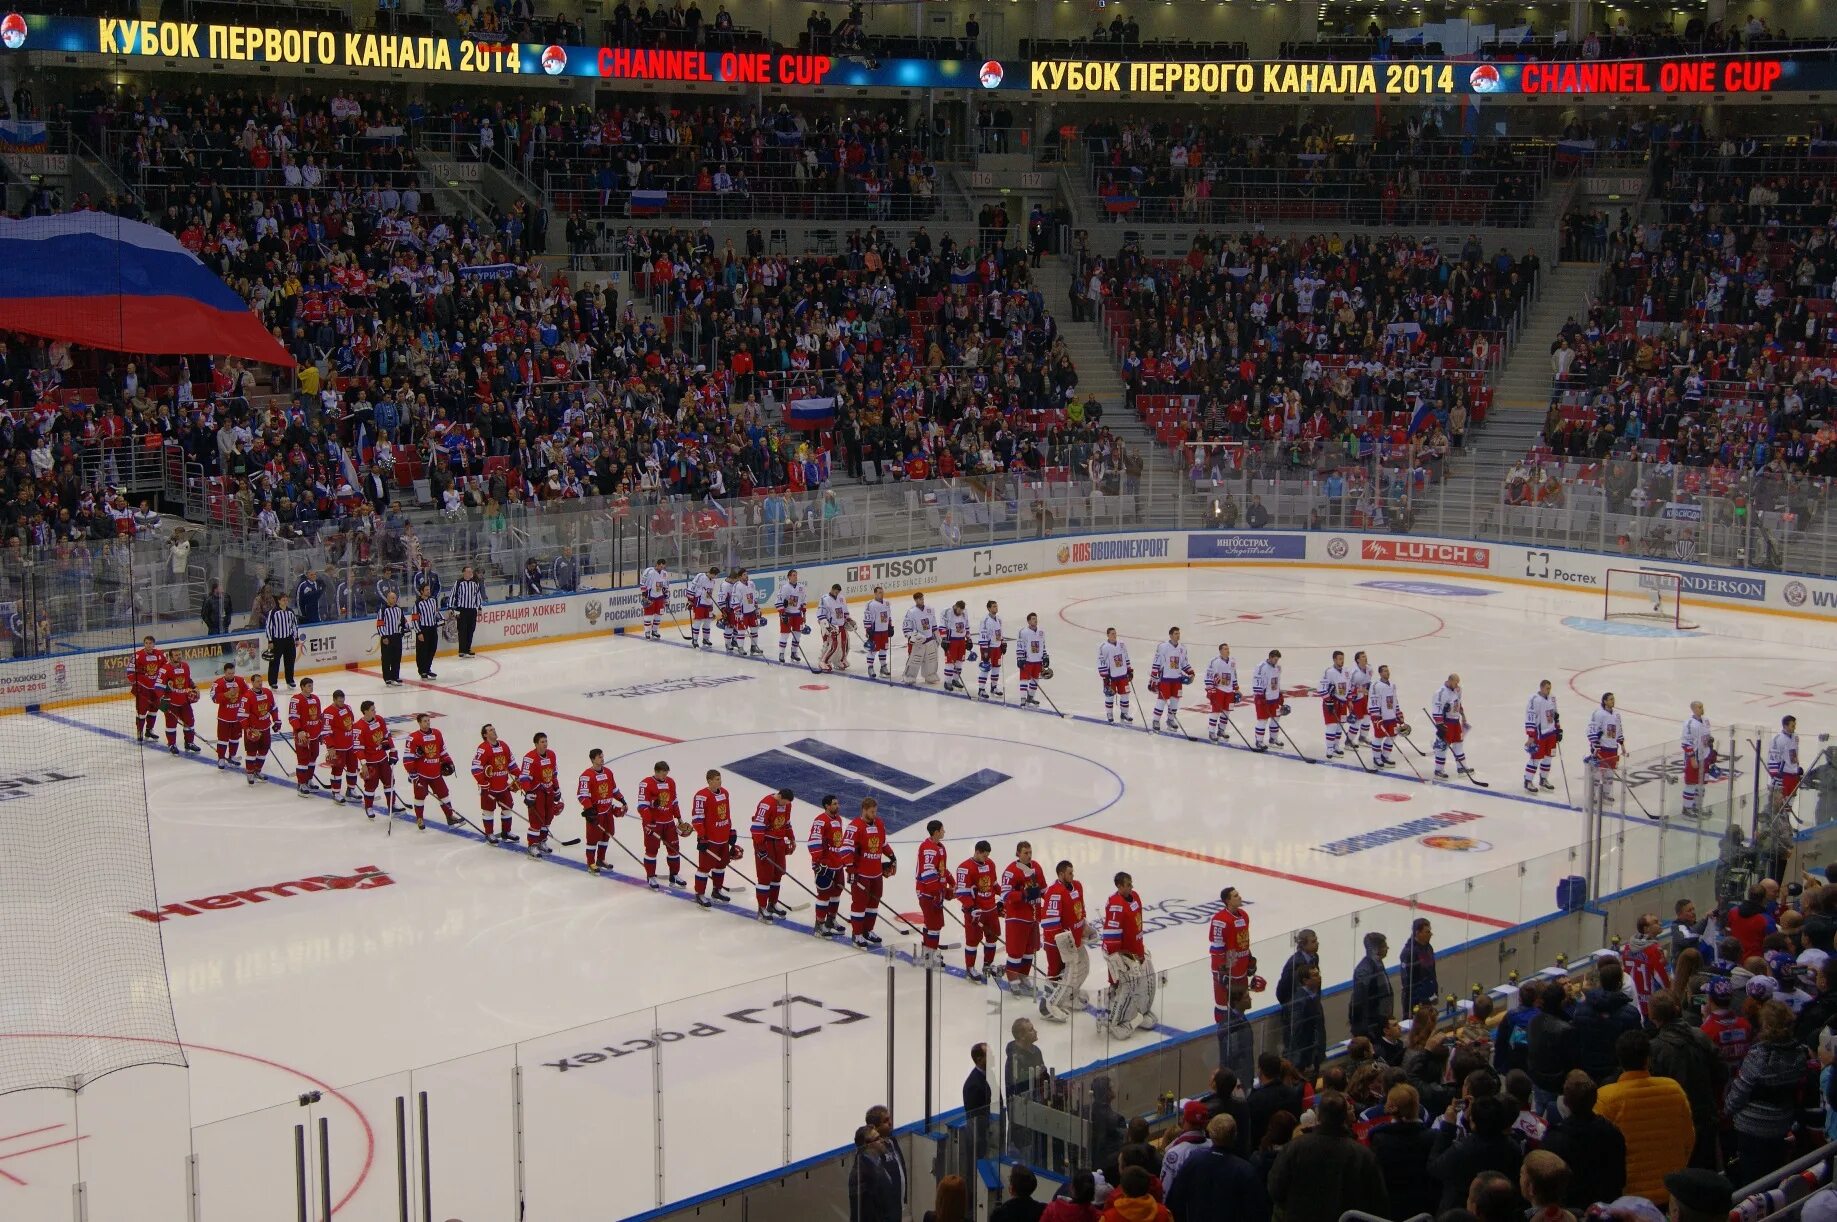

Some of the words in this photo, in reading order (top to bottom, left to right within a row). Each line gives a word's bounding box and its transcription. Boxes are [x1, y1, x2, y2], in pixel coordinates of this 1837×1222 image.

[99, 18, 199, 57] КУБОК
[209, 25, 335, 64] ПЕРВОГО
[345, 33, 452, 70] КАНАЛА
[460, 40, 520, 73] 2014
[598, 47, 713, 81] CHANNEL
[720, 52, 771, 83] ONE
[778, 55, 831, 84] CUP
[1031, 61, 1121, 90] КУБОК
[1130, 63, 1254, 92] ПЕРВОГО
[1263, 64, 1376, 93] КАНАЛА
[1385, 65, 1454, 93] 2014
[1521, 62, 1650, 94] CHANNEL
[1660, 61, 1716, 92] ONE
[1724, 60, 1782, 91] CUP
[974, 173, 991, 184] 116
[1023, 174, 1040, 184] 117
[1072, 537, 1169, 563] ROSOBORONEXPORT
[1217, 537, 1269, 547] ИНГОССТРАХ
[1395, 542, 1468, 561] LUTCH
[872, 557, 938, 580] TISSOT
[995, 562, 1028, 575] Ростех
[1554, 568, 1597, 585] Ростех
[1659, 574, 1763, 597] HENDERSON
[476, 608, 530, 624] ФЕДЕРАЦИЯ
[532, 603, 566, 616] ХОККЕЯ
[503, 623, 539, 636] РОССИИ
[185, 646, 223, 660] КАНАЛА
[1048, 901, 1057, 909] 30
[1625, 960, 1650, 992] 71
[541, 1023, 726, 1072] Ростех
